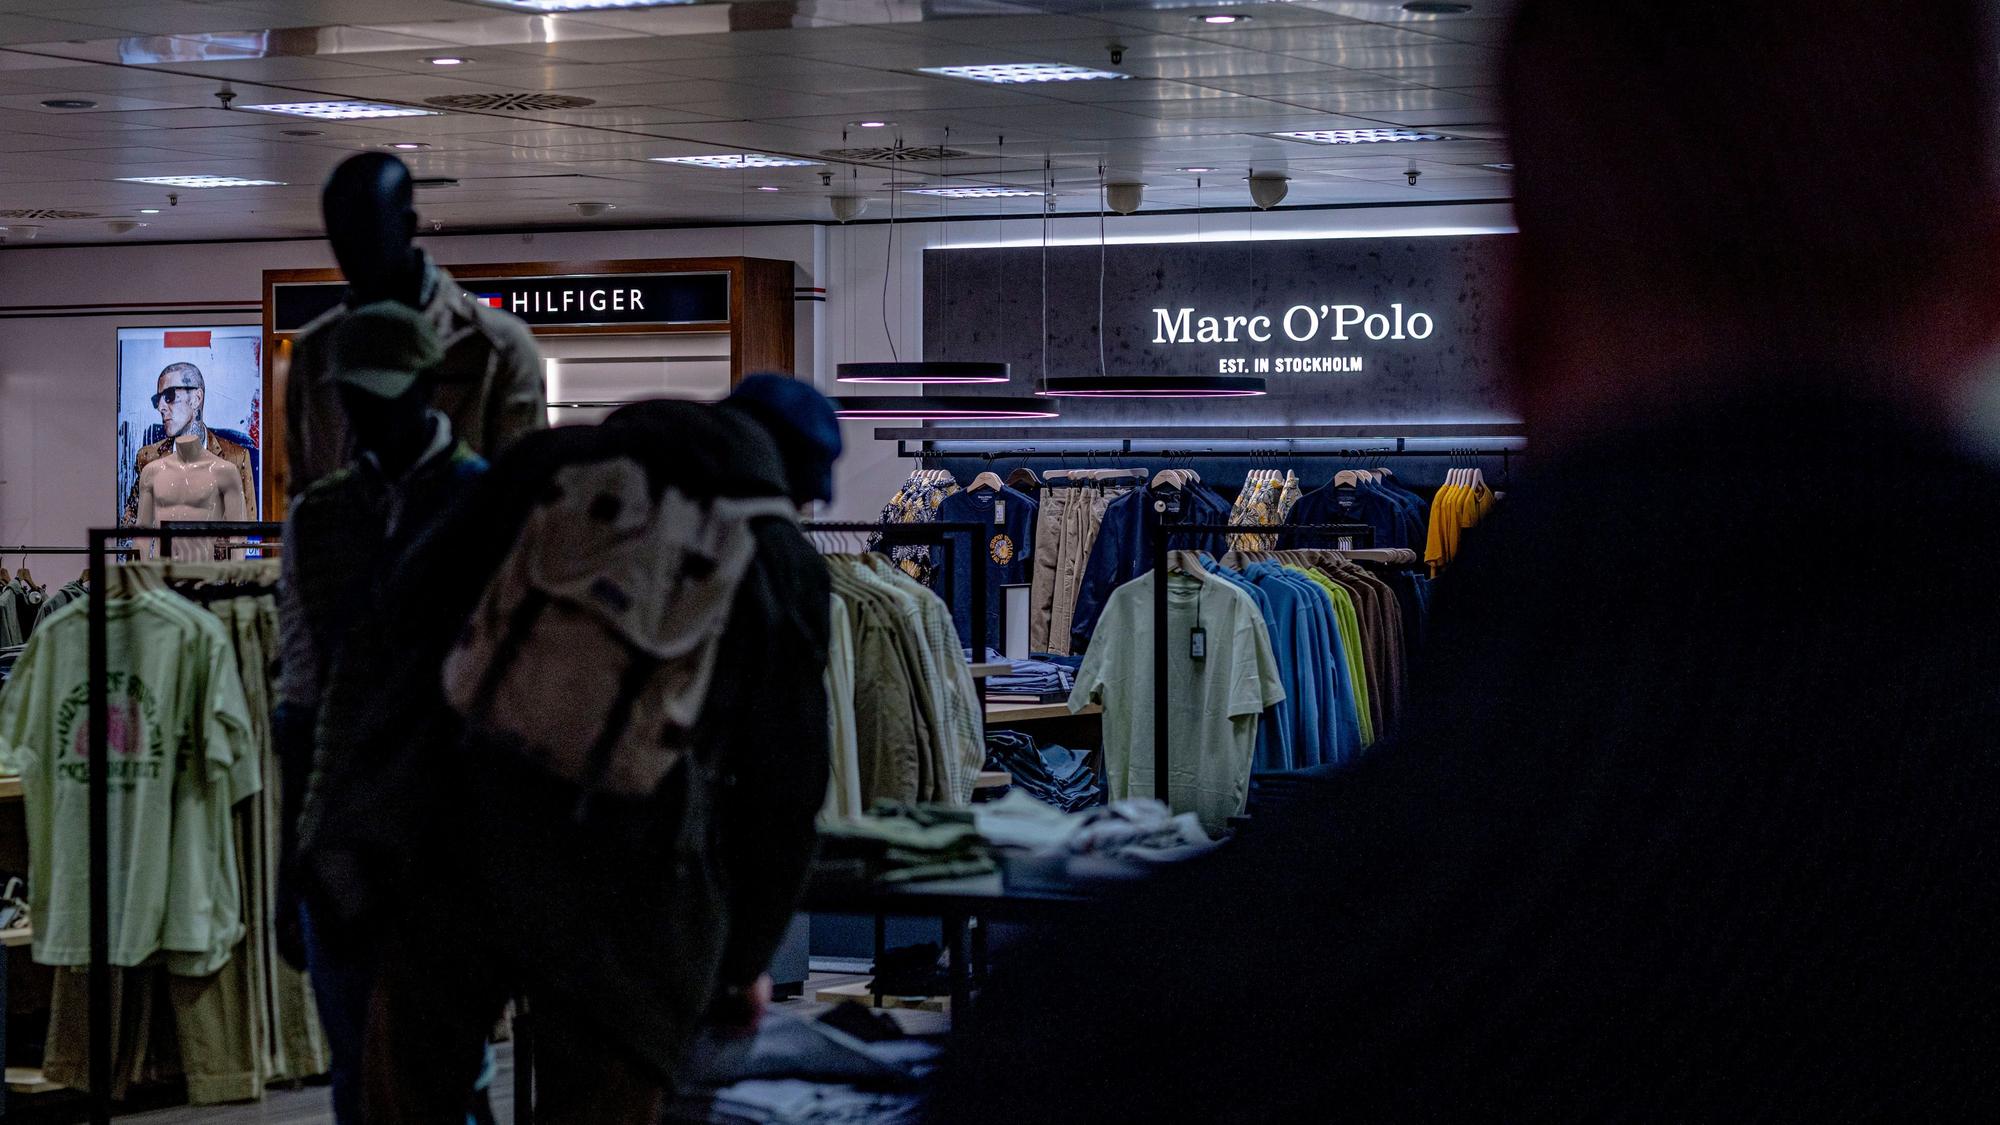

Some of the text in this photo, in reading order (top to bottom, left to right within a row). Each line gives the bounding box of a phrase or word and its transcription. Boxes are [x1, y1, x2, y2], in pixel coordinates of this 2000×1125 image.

[512, 289, 645, 313] HILFIGER
[1152, 303, 1434, 344] Marc O'Polo
[1218, 356, 1363, 374] EST. IN STOCKHOLM
